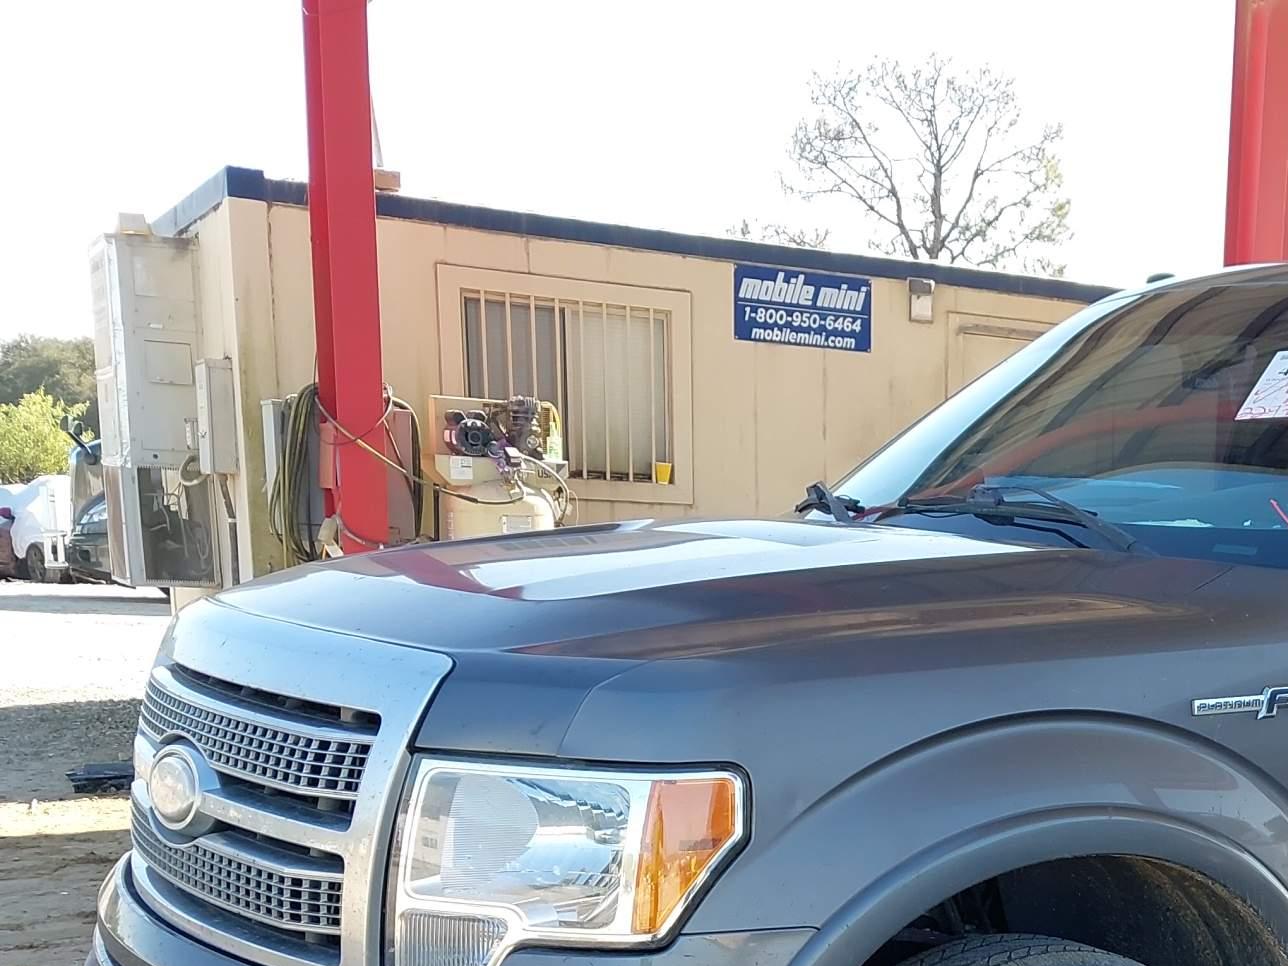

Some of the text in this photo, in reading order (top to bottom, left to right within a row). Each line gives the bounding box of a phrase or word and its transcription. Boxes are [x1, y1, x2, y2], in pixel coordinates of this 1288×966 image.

[738, 272, 868, 311] mobile mini
[744, 306, 862, 333] 1-800-950-6464
[751, 327, 856, 349] mobilemini.com
[1199, 698, 1261, 713] PLATINUM
